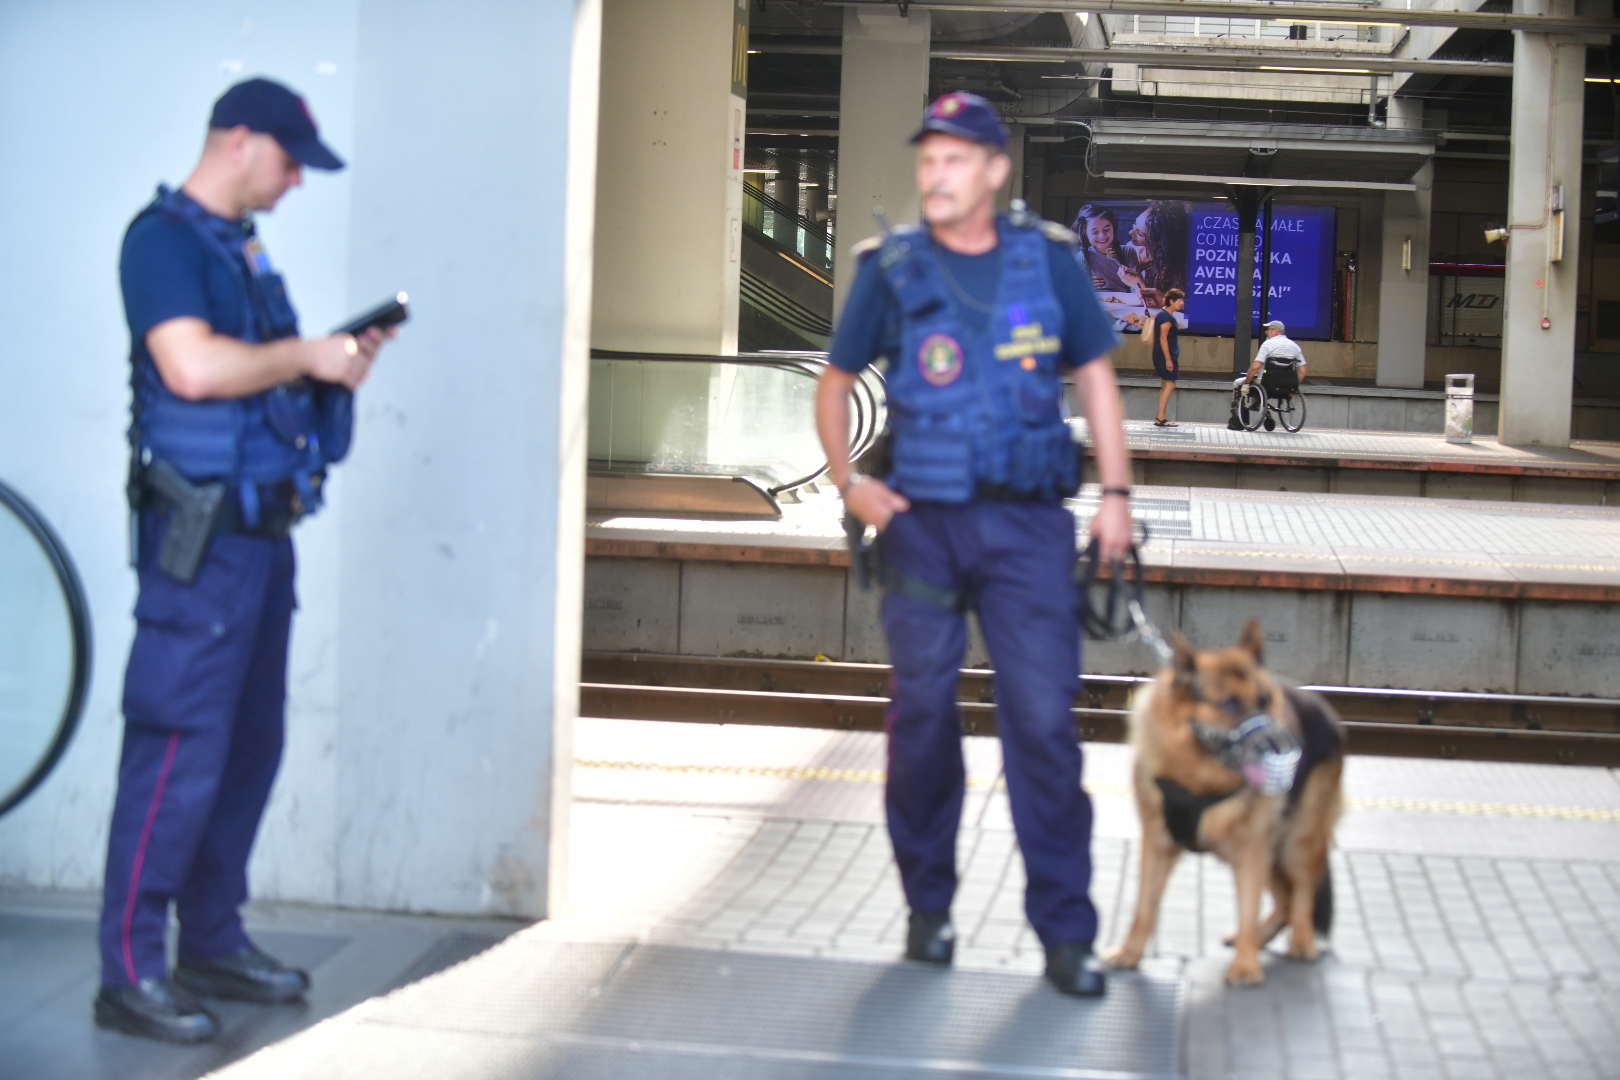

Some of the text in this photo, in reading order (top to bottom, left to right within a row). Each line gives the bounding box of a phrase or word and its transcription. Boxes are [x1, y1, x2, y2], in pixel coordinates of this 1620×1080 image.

[1196, 233, 1263, 248] CO NIEO
[1194, 266, 1262, 281] AVENA
